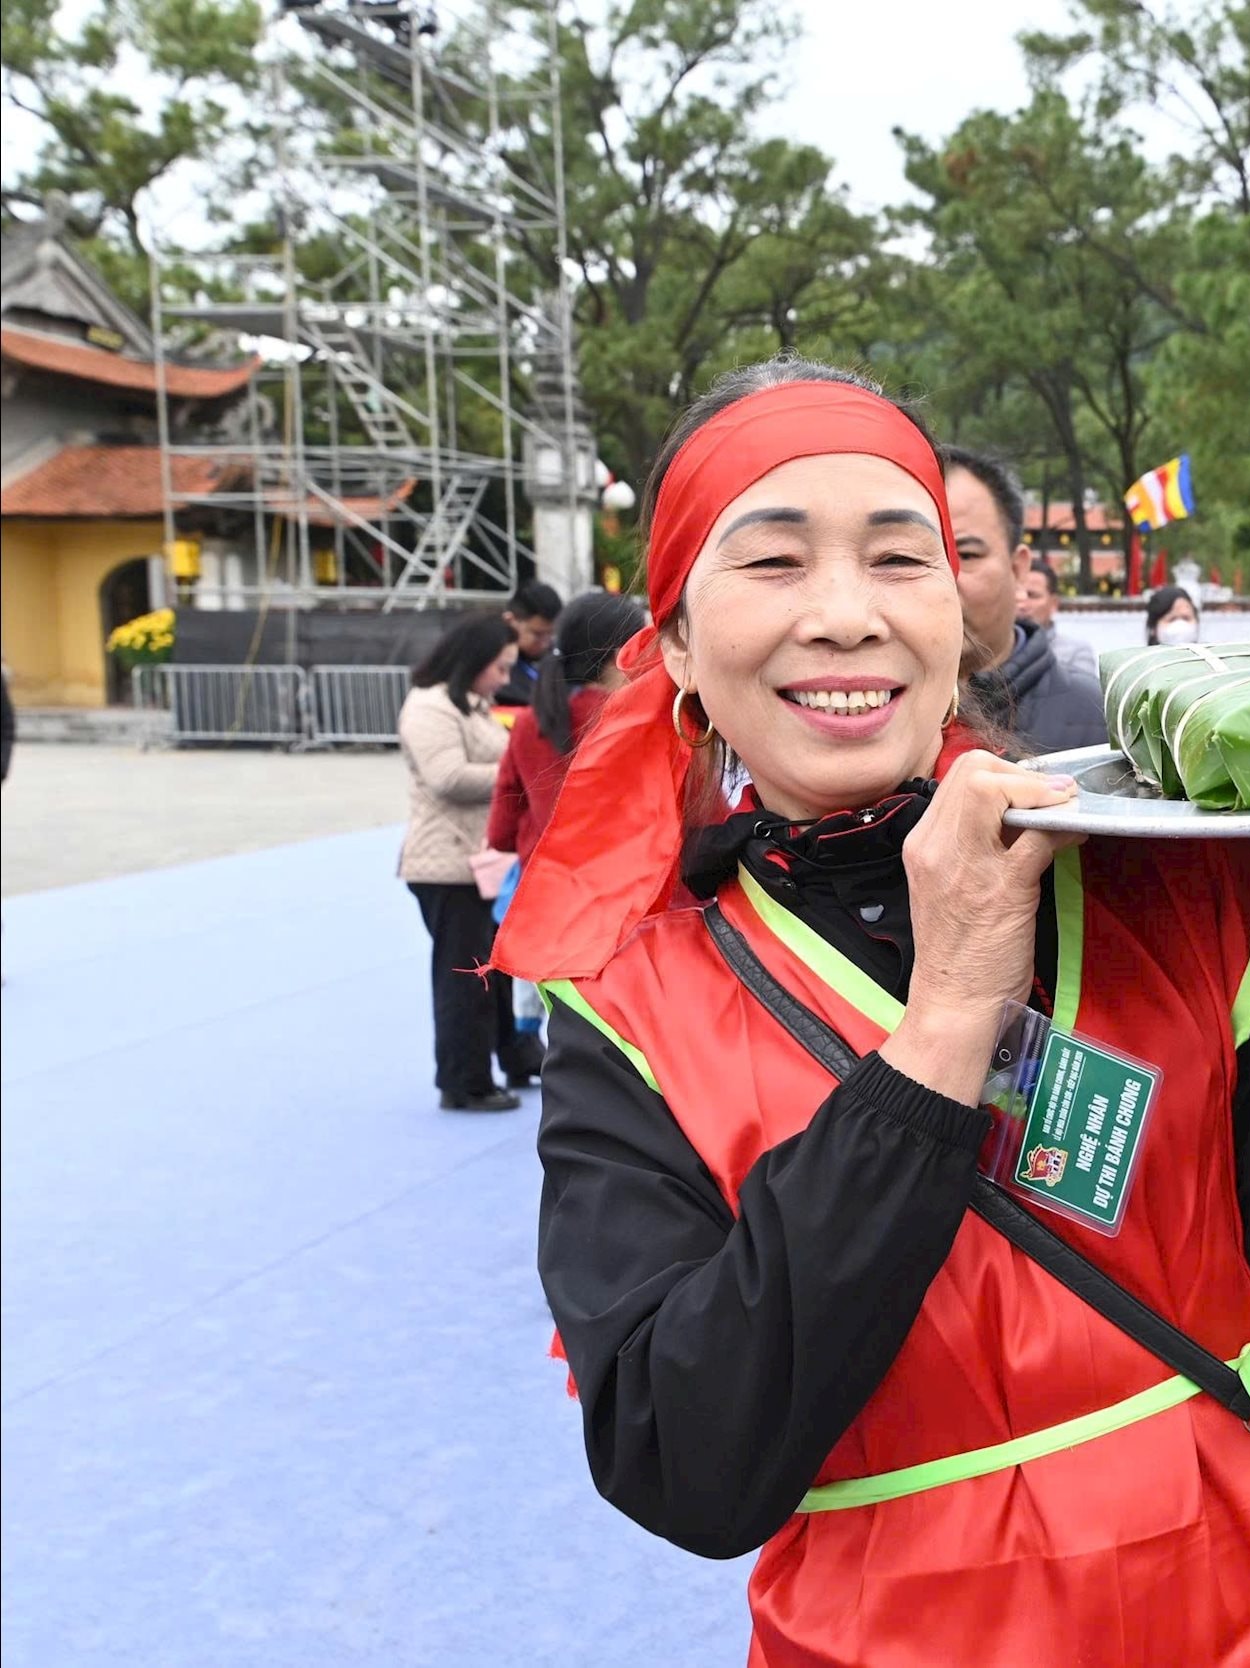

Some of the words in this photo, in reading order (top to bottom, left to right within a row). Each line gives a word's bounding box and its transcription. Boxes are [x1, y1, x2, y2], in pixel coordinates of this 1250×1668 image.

[1085, 1094, 1109, 1135] NHÂN
[1115, 1078, 1142, 1127] CHƯNG
[1075, 1133, 1101, 1172] NGHỆ
[1104, 1126, 1128, 1166] BÁNH
[1098, 1164, 1117, 1187] THI
[1093, 1184, 1113, 1209] DỰ
